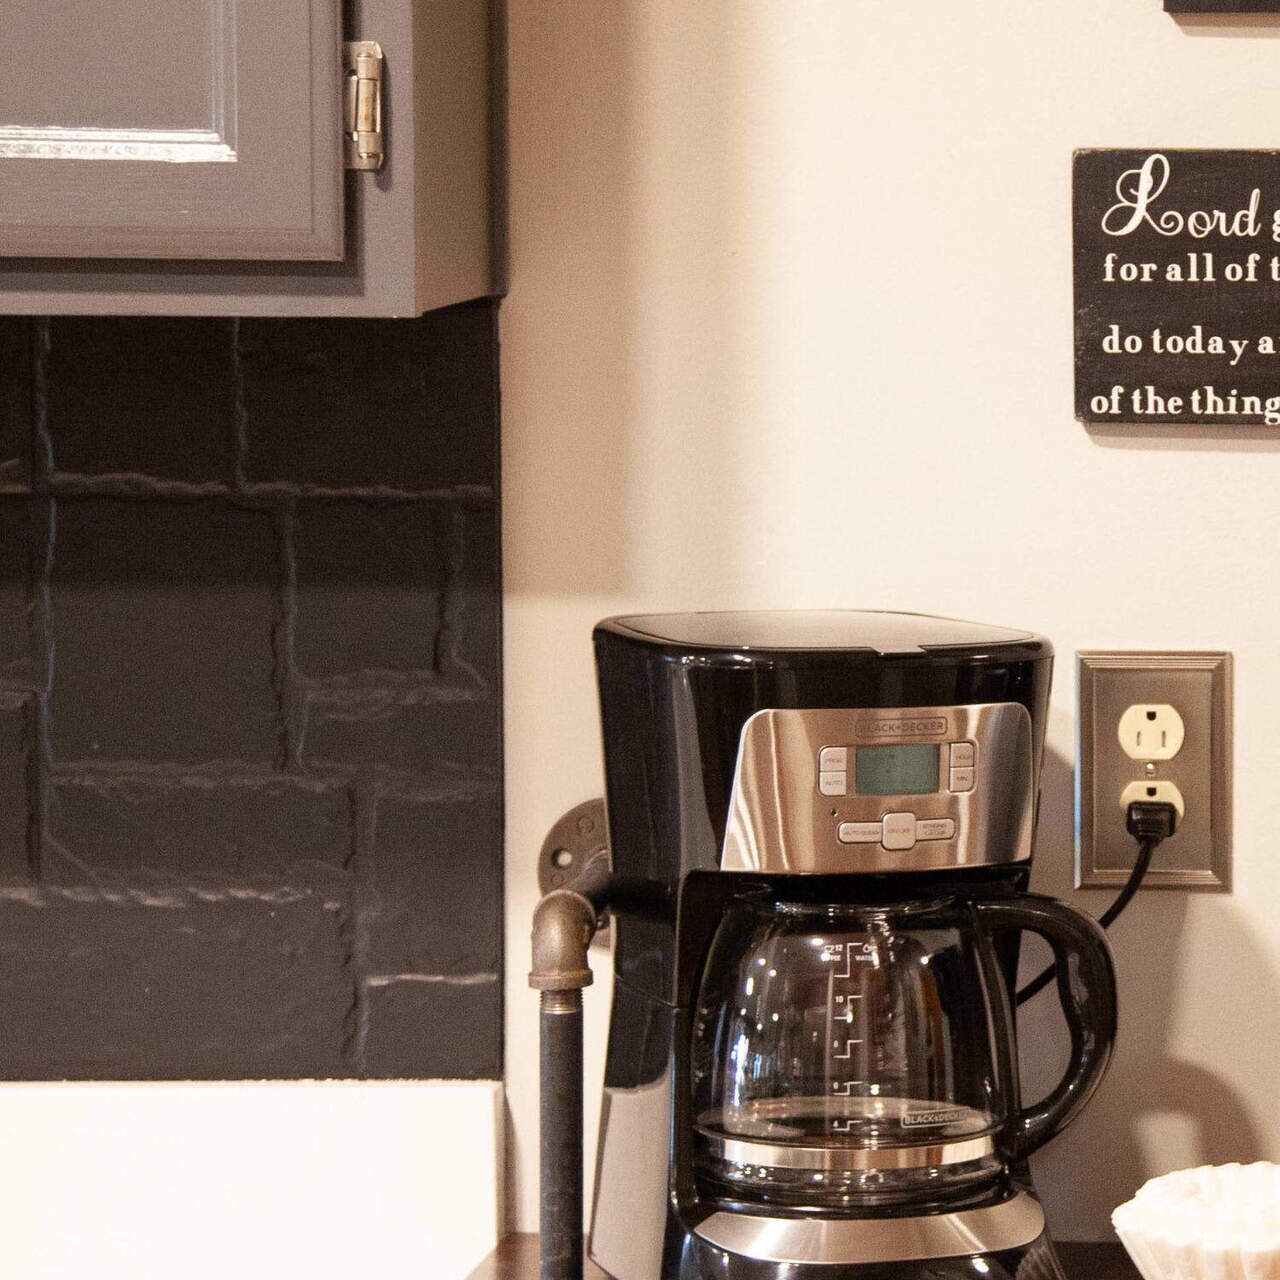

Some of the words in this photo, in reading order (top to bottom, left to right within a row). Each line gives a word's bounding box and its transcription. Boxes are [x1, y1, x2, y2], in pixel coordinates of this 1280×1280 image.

[1101, 152, 1262, 240] Lord
[1103, 252, 1158, 283] for
[1165, 252, 1216, 283] all
[1224, 252, 1261, 283] of
[1102, 324, 1143, 355] do
[1151, 325, 1250, 366] today
[1090, 385, 1126, 415] of
[1131, 386, 1184, 416] the
